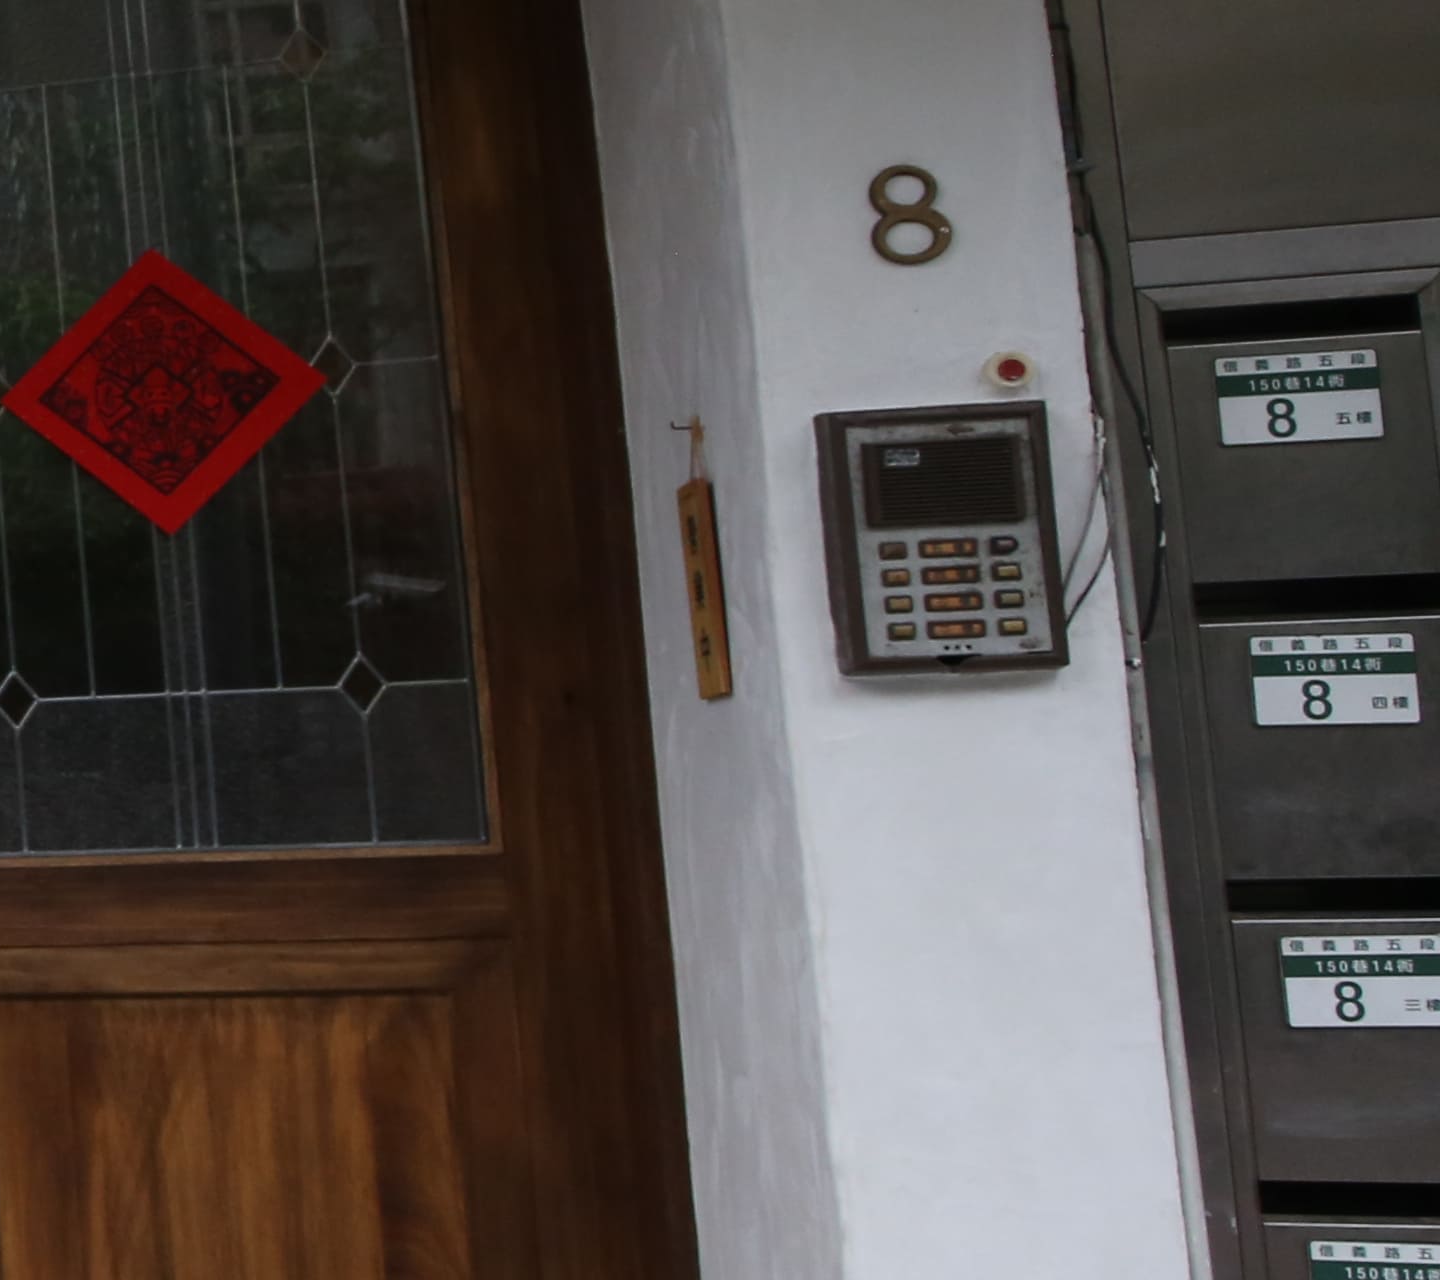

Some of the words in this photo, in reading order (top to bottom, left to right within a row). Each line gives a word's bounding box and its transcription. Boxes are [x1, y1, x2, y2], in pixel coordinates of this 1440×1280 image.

[868, 164, 952, 266] 8
[1223, 352, 1366, 372] 信義路五段
[1266, 398, 1297, 438] 8
[1335, 411, 1372, 425] 五樓
[1258, 637, 1403, 651] 信義路五段
[1301, 679, 1333, 720] 8
[1371, 696, 1408, 710] 四樓
[1289, 938, 1435, 952] 信義路五段
[1334, 981, 1365, 1022] 8
